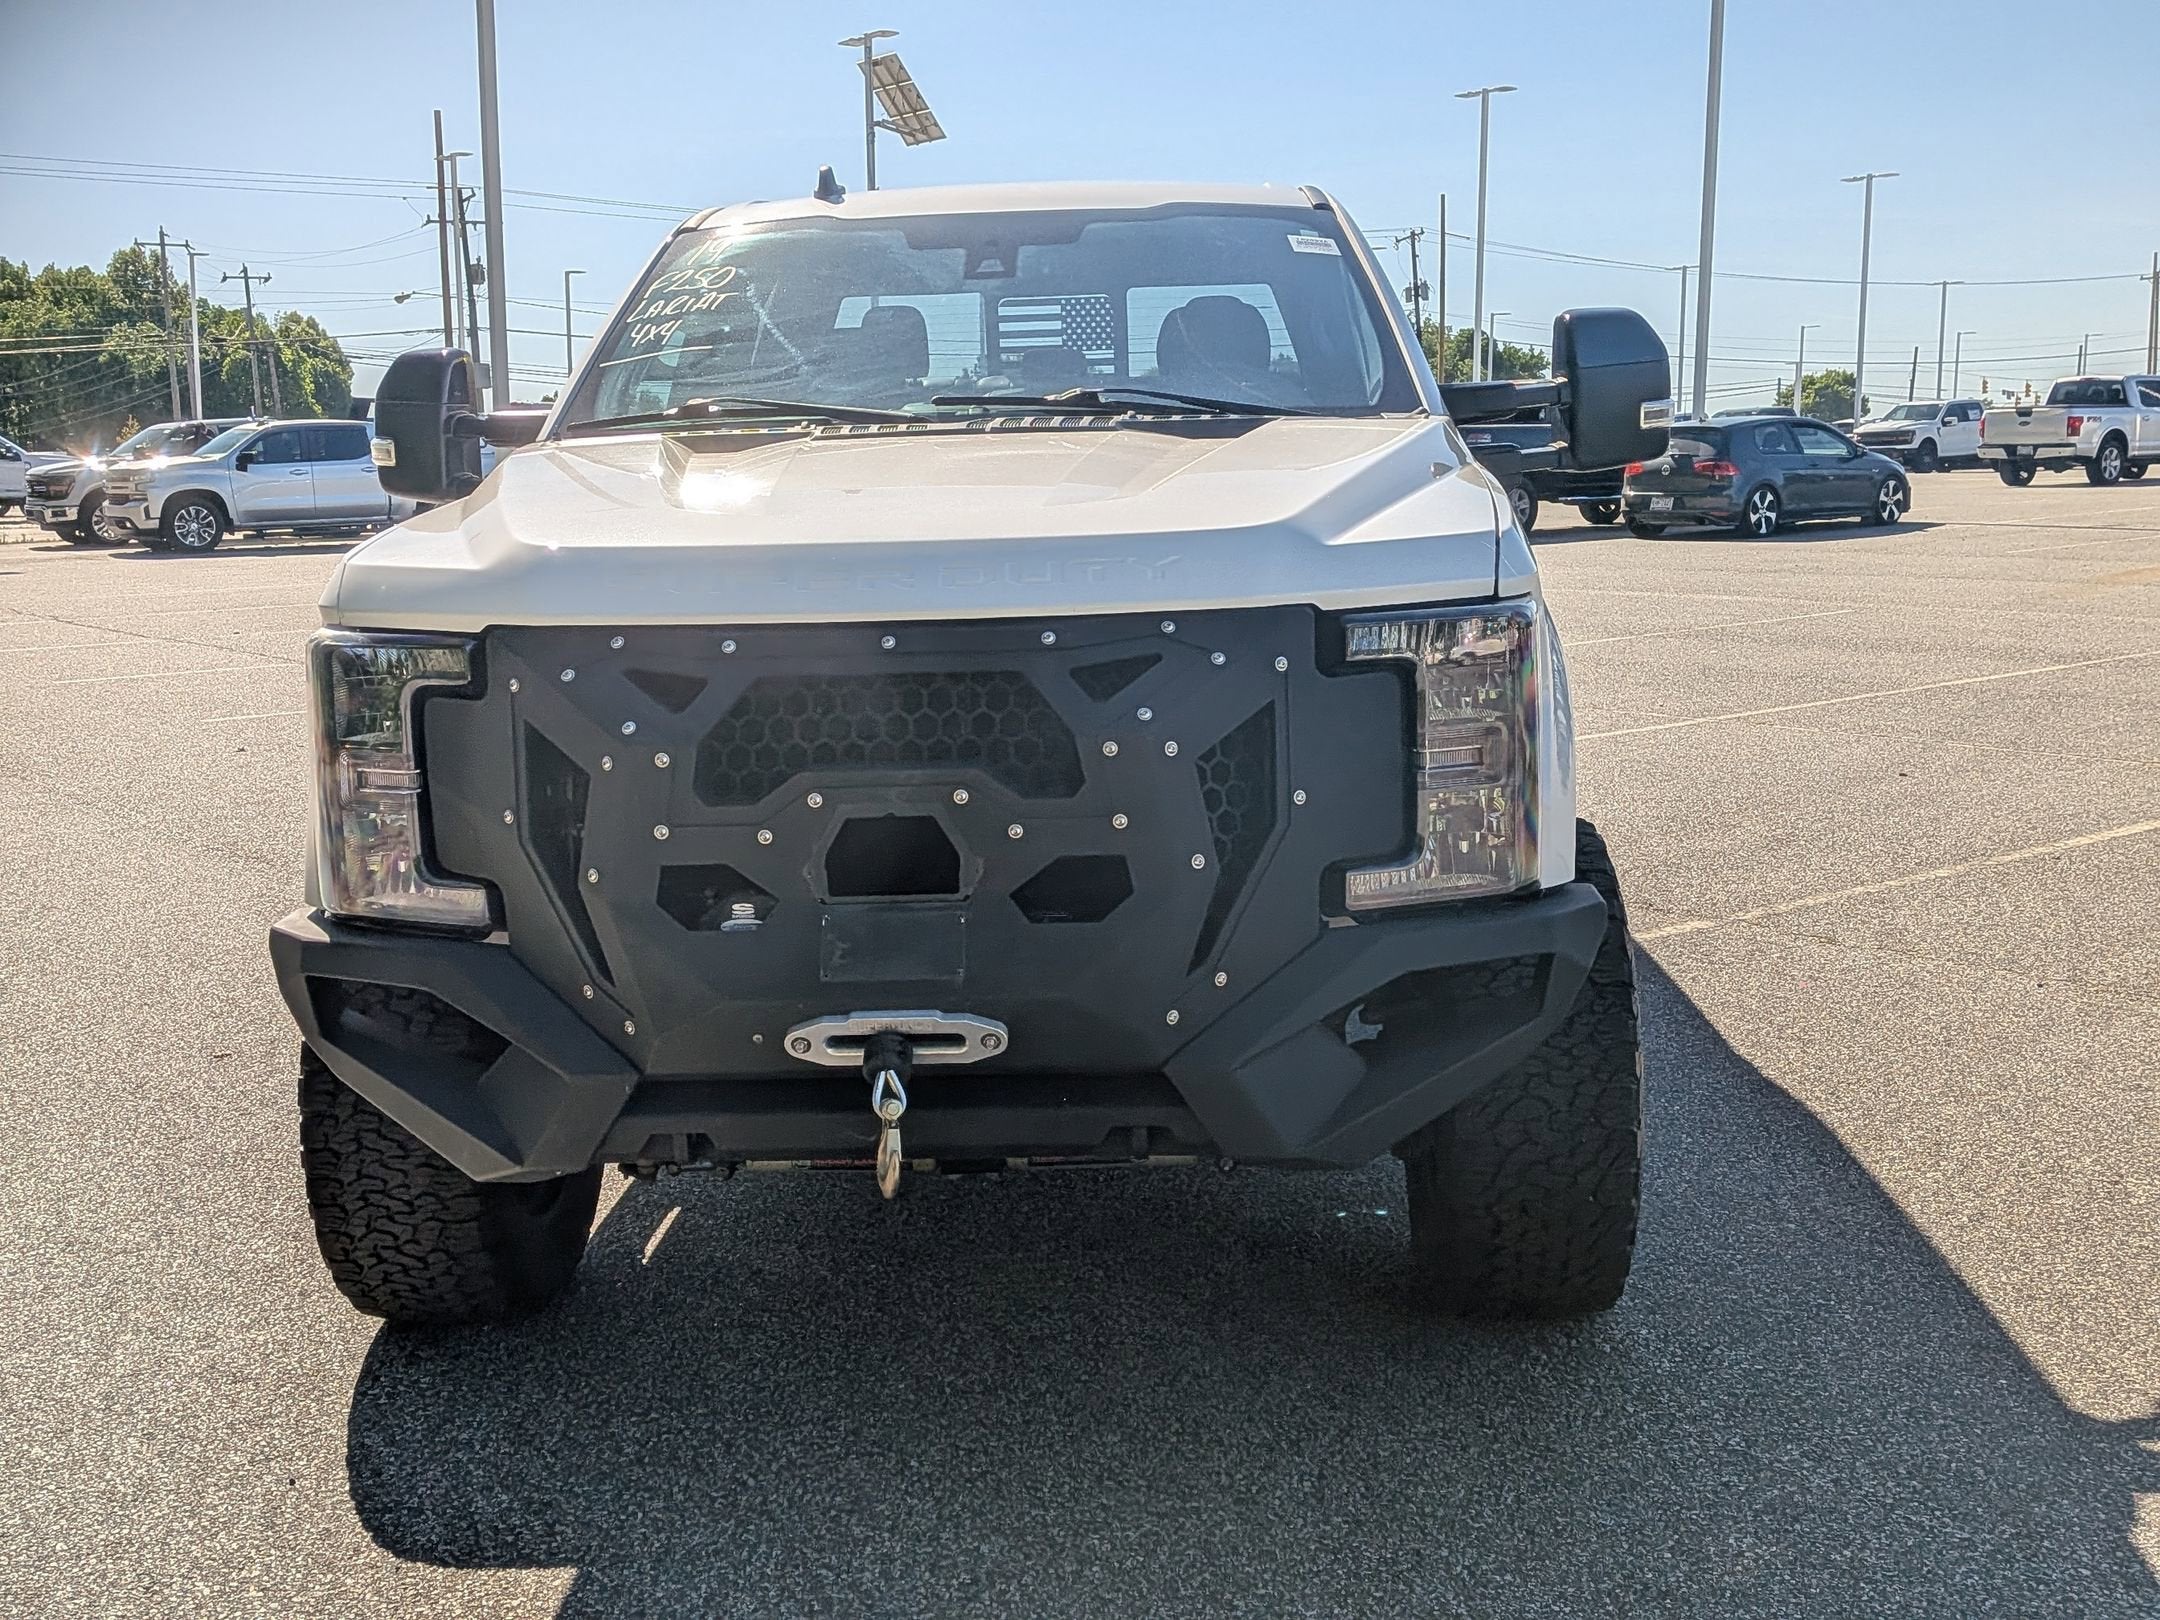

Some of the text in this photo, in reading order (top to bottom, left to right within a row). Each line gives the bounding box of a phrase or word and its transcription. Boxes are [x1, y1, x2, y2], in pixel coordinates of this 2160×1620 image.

[687, 239, 733, 266] 19
[643, 266, 737, 298] F250
[626, 291, 739, 323] LARIAT
[937, 554, 1182, 590] DUTY
